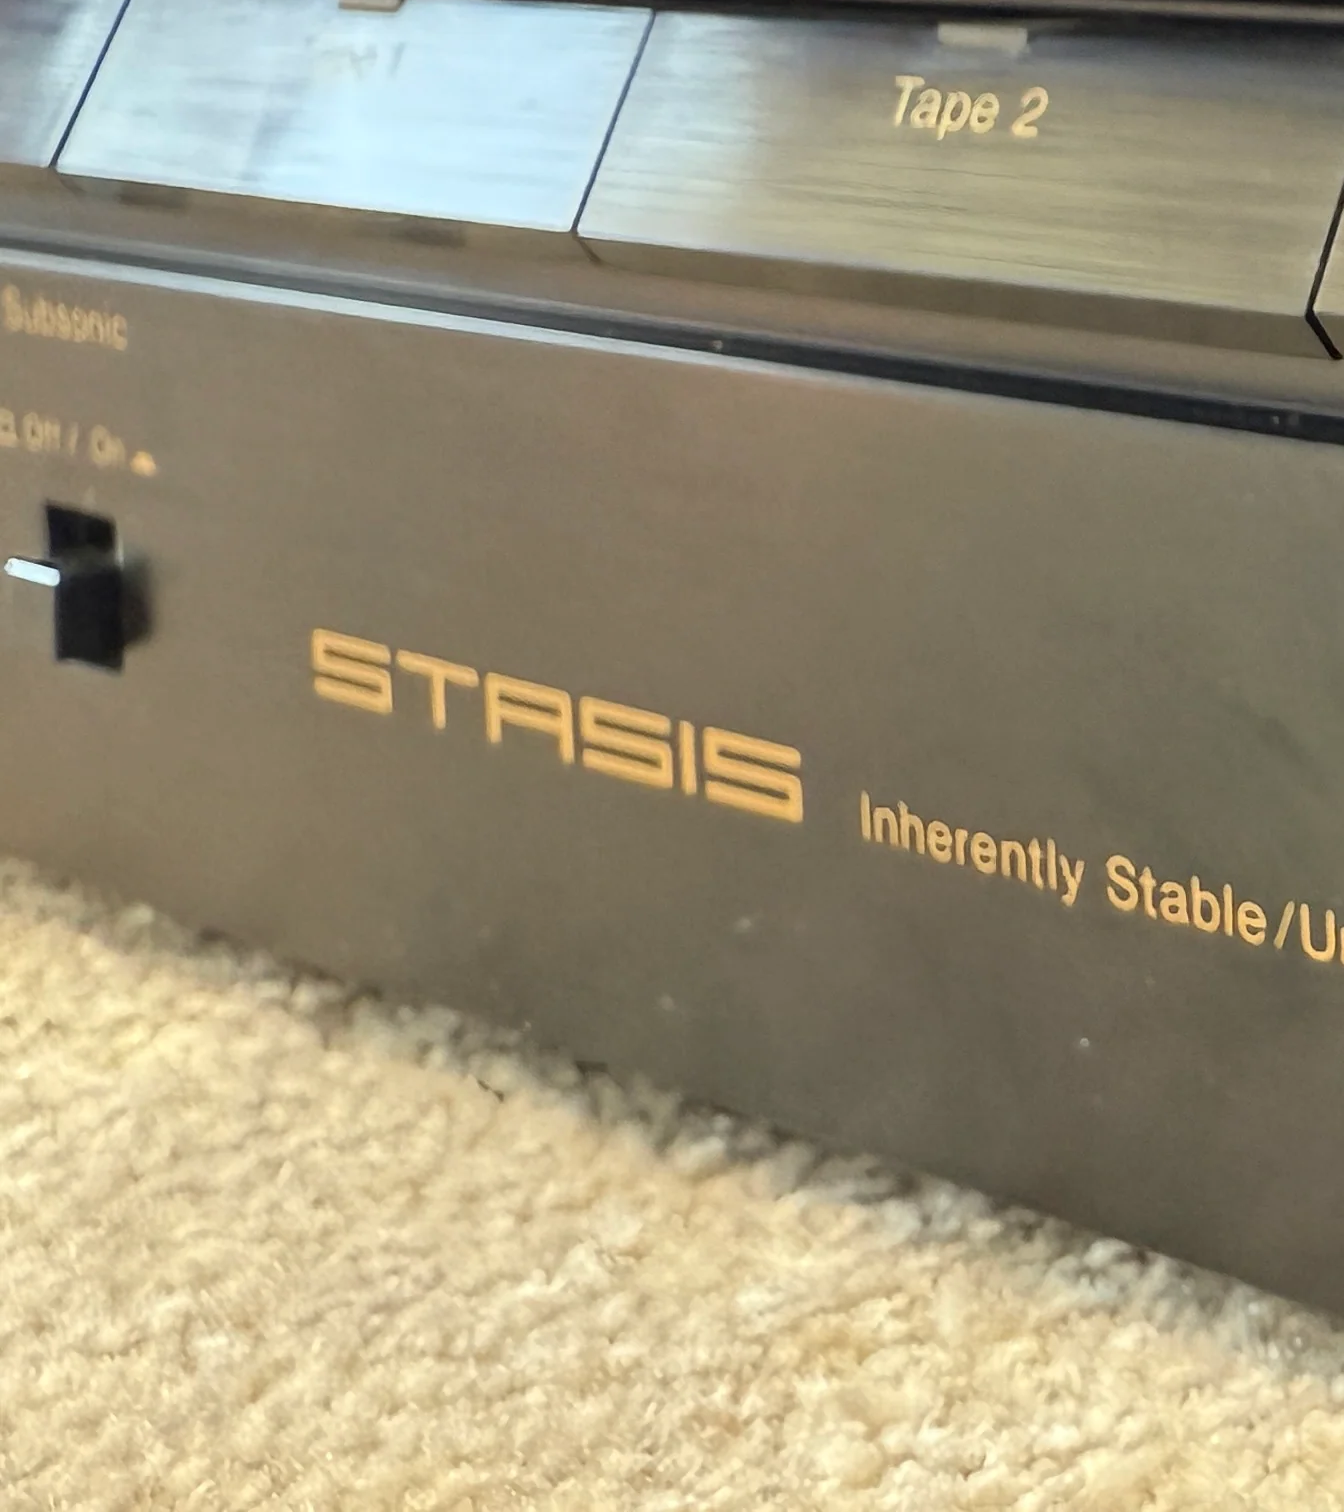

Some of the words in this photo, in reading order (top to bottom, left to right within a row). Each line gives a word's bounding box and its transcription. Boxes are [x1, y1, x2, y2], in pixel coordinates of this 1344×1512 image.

[894, 75, 1000, 141] Tape
[1010, 87, 1050, 139] 2
[311, 628, 804, 824] STASIS
[860, 790, 1086, 906] Inherently
